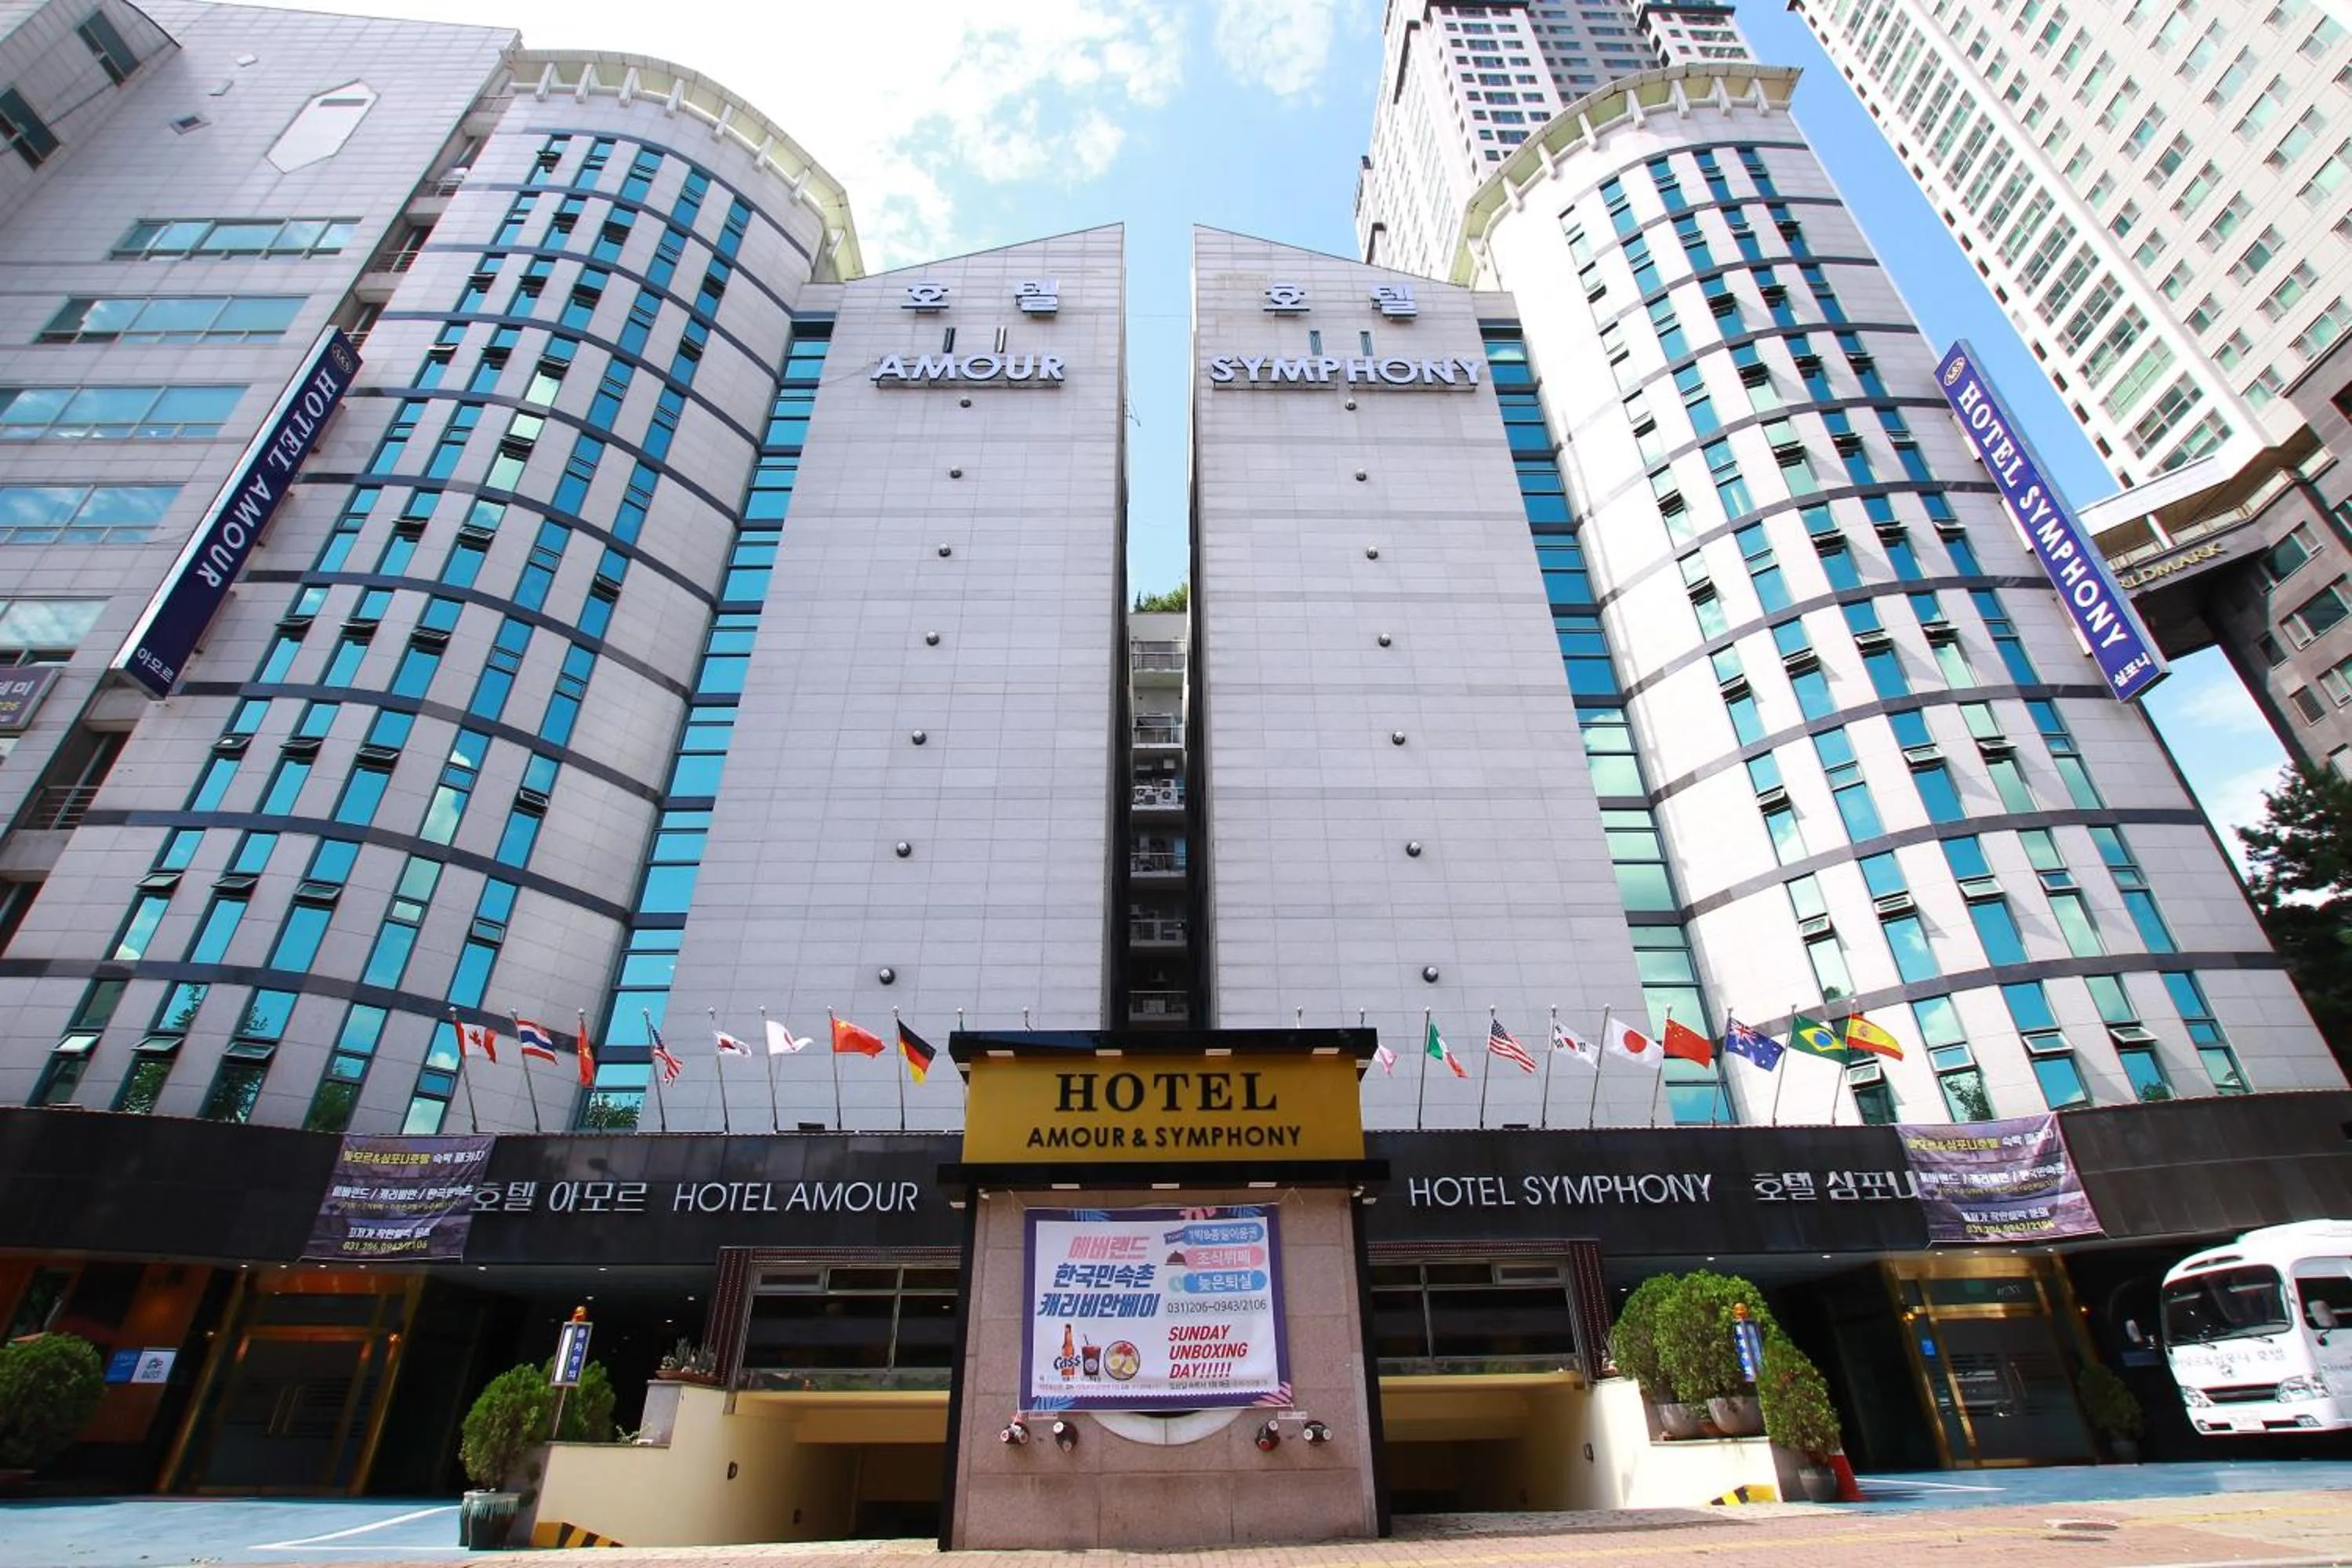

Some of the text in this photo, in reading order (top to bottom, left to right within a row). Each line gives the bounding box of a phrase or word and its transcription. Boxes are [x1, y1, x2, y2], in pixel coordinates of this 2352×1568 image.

[871, 353, 1065, 382] AMOUR
[1210, 354, 1483, 386] SYMPHONY
[196, 368, 339, 588] HOTEL AMOUR
[1958, 381, 2127, 650] HOTEL SYMPHONY
[136, 647, 173, 683] 아모르
[2114, 652, 2152, 688] 심포니
[1054, 1073, 1277, 1112] HOTEL
[1026, 1125, 1301, 1148] AMOUR & SYMPHONY
[468, 1181, 648, 1213] 호텔 아모르
[673, 1181, 919, 1211] HOTEL AMOUR
[1409, 1174, 1711, 1206] HOTEL SYMPHONY
[1751, 1171, 1817, 1201] 호텔
[1826, 1171, 1919, 1200] 심포니
[1068, 1236, 1149, 1259] 에버랜드
[1054, 1263, 1156, 1288] 한국민속촌
[1199, 1272, 1252, 1291] 늦은퇴실
[1036, 1293, 1161, 1318] 캐리비안베이
[1168, 1325, 1231, 1341] SUNDAY
[1169, 1342, 1248, 1360] UNBOXING
[1169, 1362, 1232, 1379] DAY!!!!!
